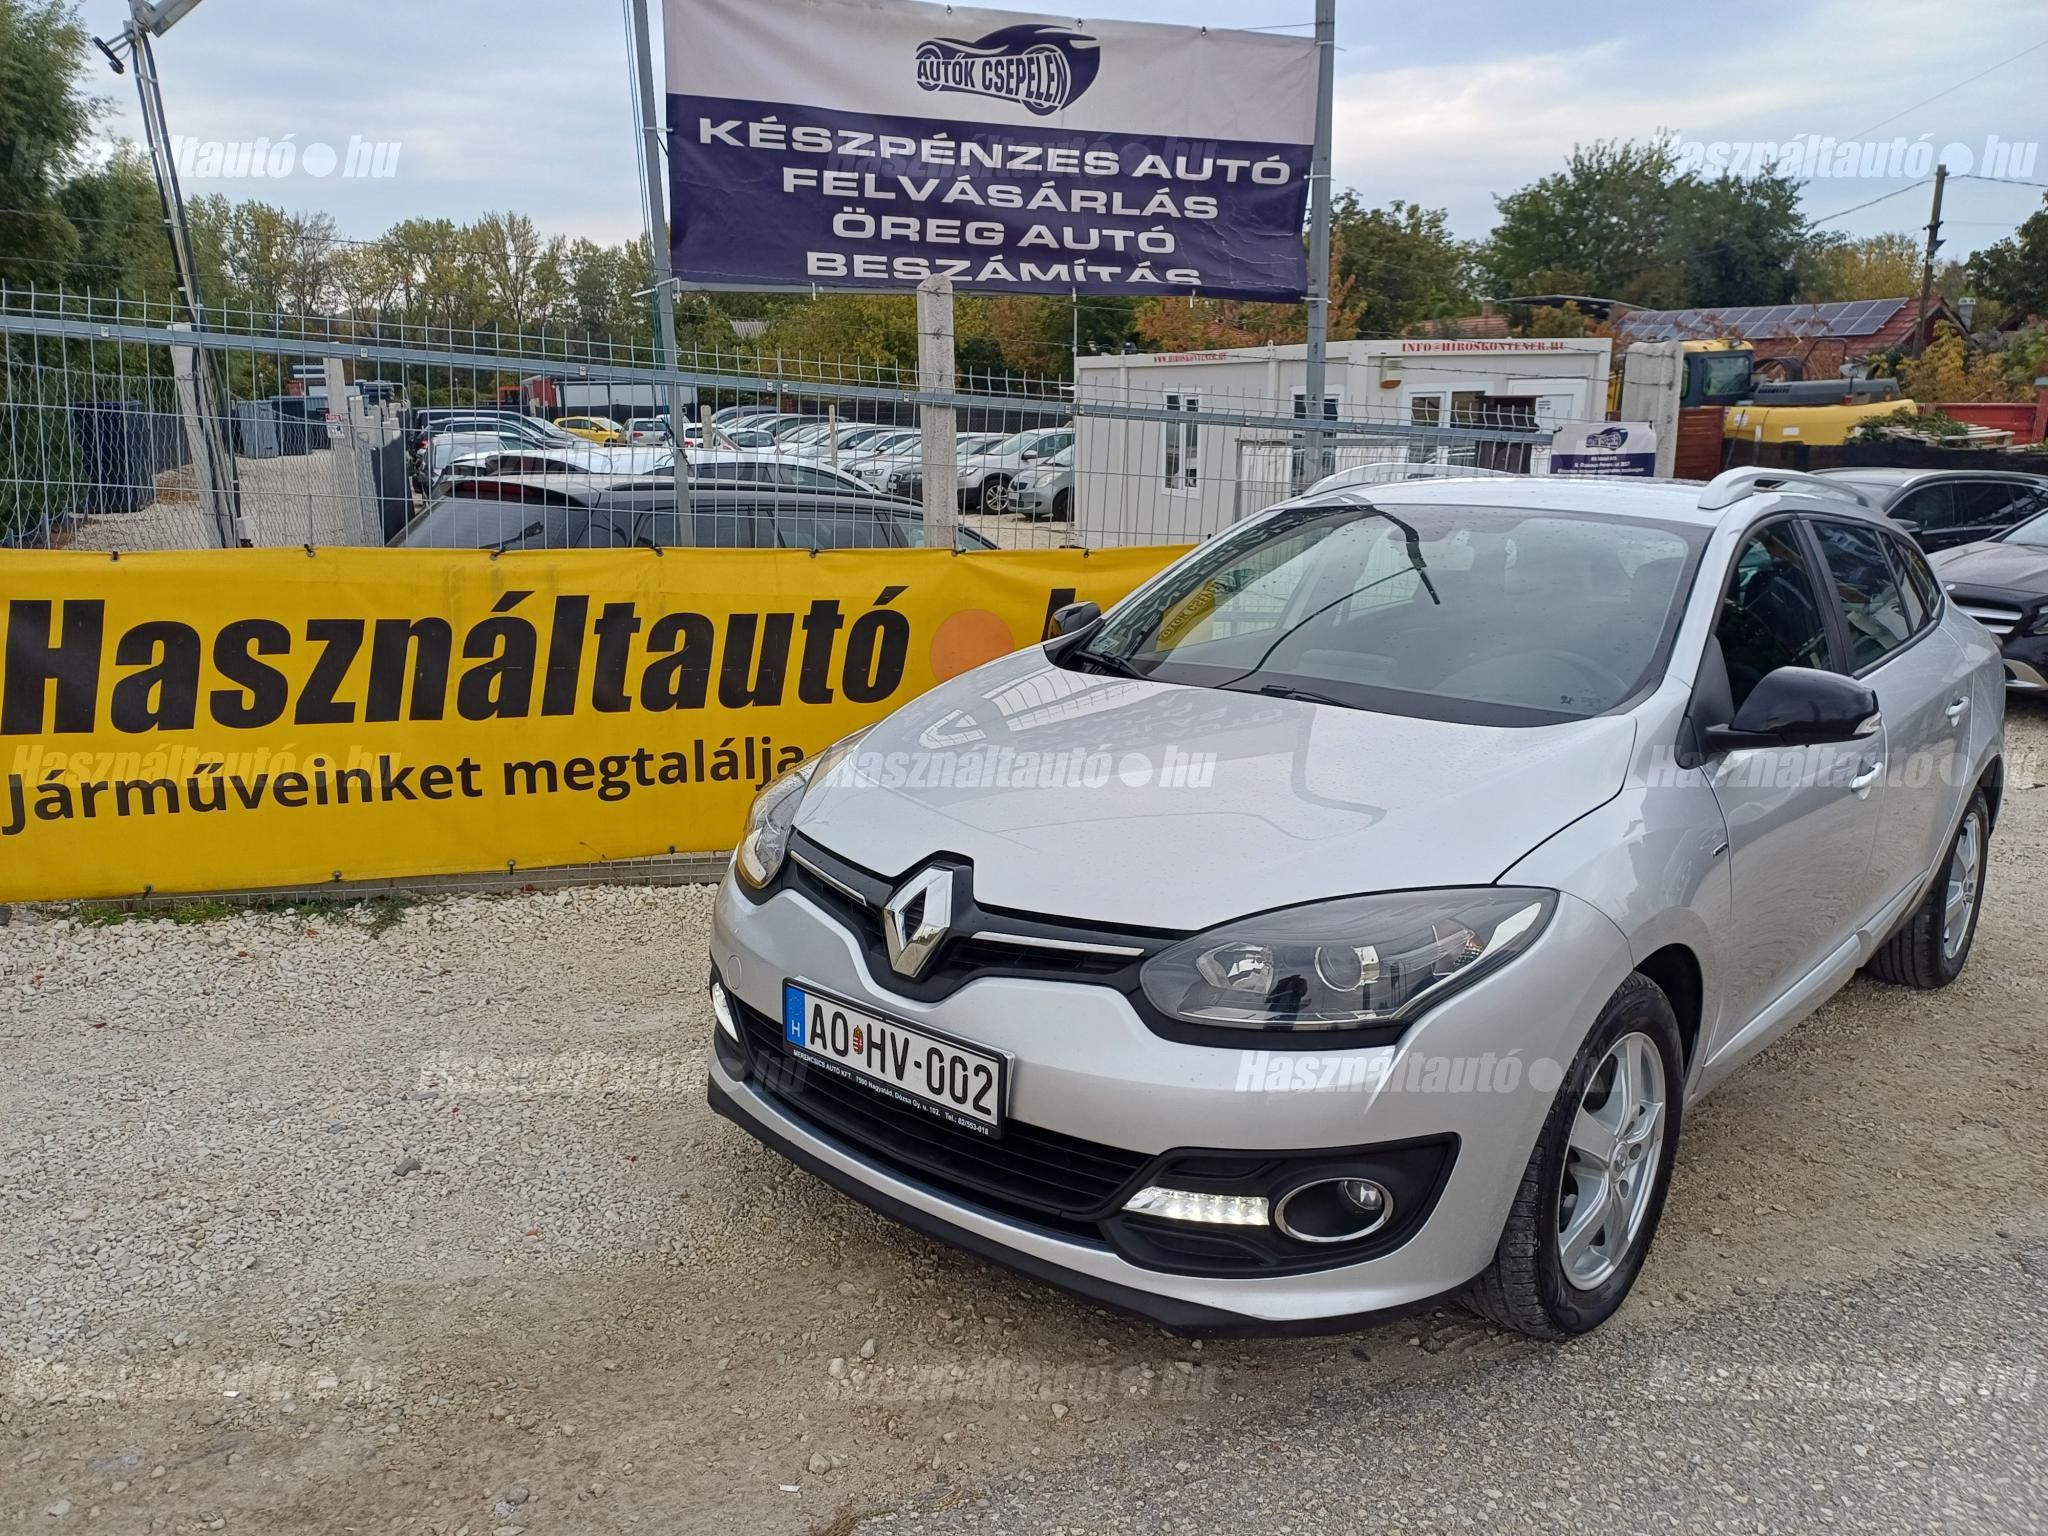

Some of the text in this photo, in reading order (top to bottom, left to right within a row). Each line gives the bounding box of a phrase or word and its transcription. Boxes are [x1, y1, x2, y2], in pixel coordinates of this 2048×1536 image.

[916, 52, 1069, 106] AUTÓK CSEPELEN
[699, 115, 1291, 186] KÉSZPÉNZES AUTÓ
[783, 166, 1219, 220] FELVÁSÁRLÁS
[832, 206, 1176, 255] ÖREG AUTÓ
[806, 251, 1202, 286] BESZÁMÍTÁS
[0, 585, 910, 736] Használtautó
[1, 736, 806, 837] Járműveinket megtalálja
[790, 1003, 994, 1117] H AO HV-002
